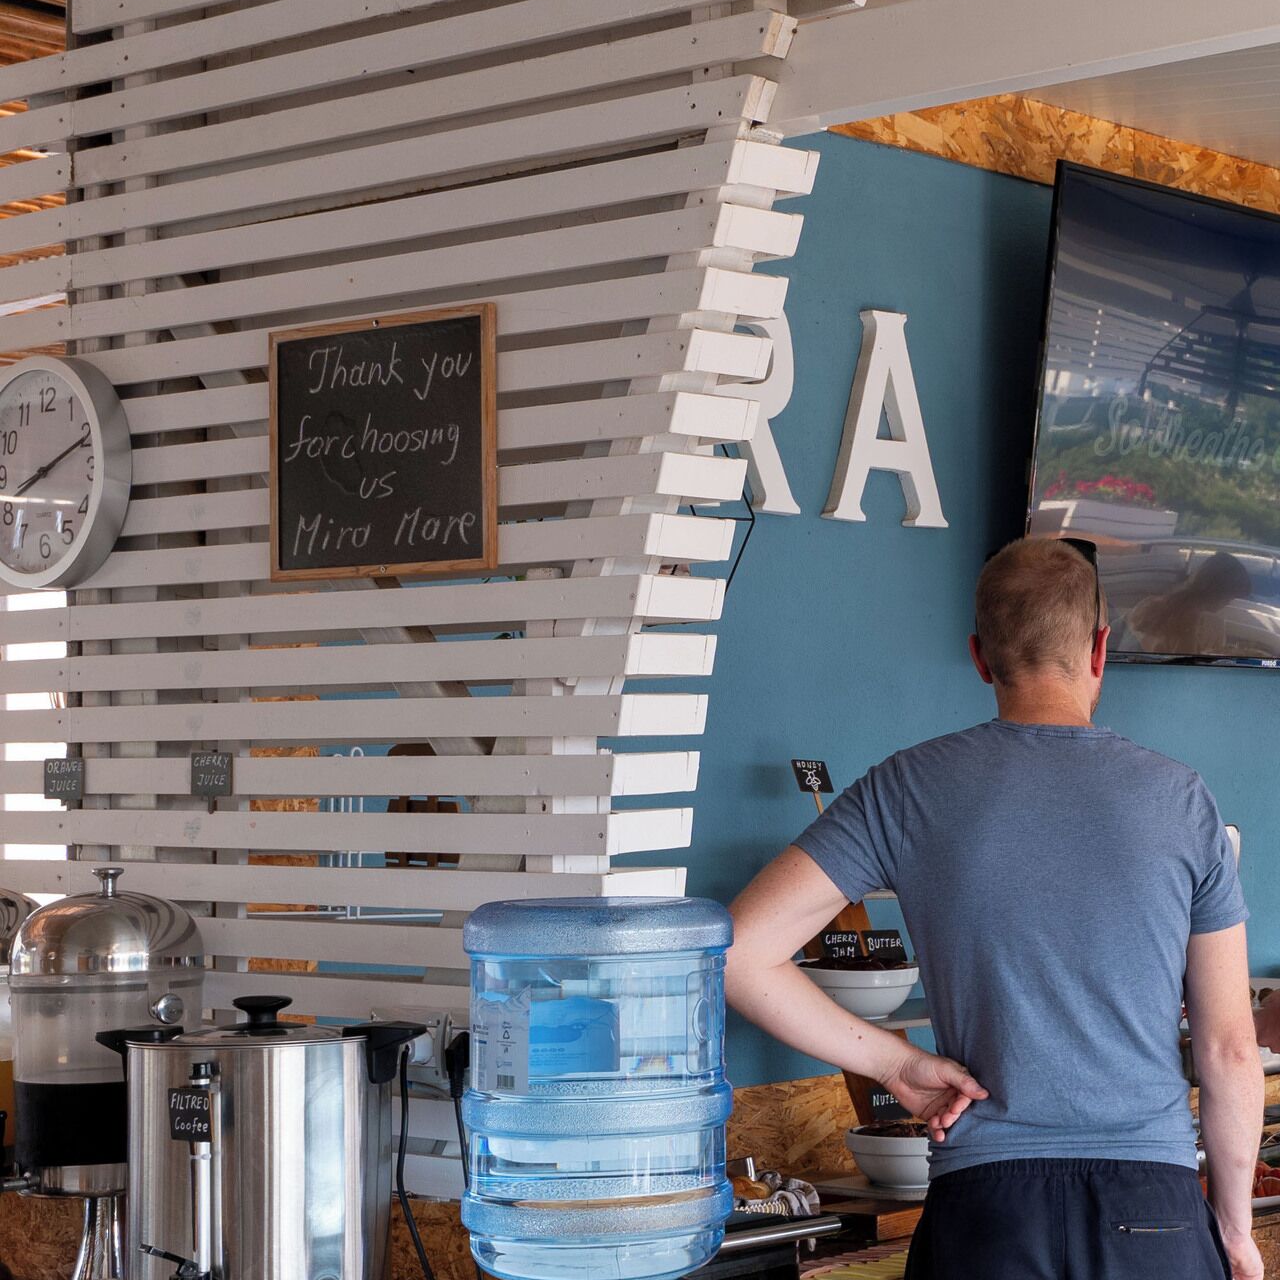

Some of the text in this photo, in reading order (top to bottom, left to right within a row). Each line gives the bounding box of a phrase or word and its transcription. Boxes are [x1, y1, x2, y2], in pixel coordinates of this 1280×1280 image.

[308, 341, 473, 401] Thank you
[39, 386, 57, 413] 12
[18, 401, 31, 427] 11
[2, 430, 18, 456] 10
[80, 422, 92, 448] 2
[284, 412, 460, 466] for choosing
[359, 471, 397, 500] us
[3, 501, 14, 526] 8
[78, 494, 89, 516] 4
[62, 520, 74, 546] 5
[39, 533, 52, 560] 6
[193, 752, 229, 769] CHERRY
[49, 780, 78, 793] JUICE
[197, 773, 226, 786] JUICE
[825, 933, 858, 945] CHERRY
[867, 937, 903, 951] BUTTER
[832, 946, 855, 958] JAM
[170, 1092, 210, 1111] FILTRED
[174, 1116, 209, 1134] Coofee
